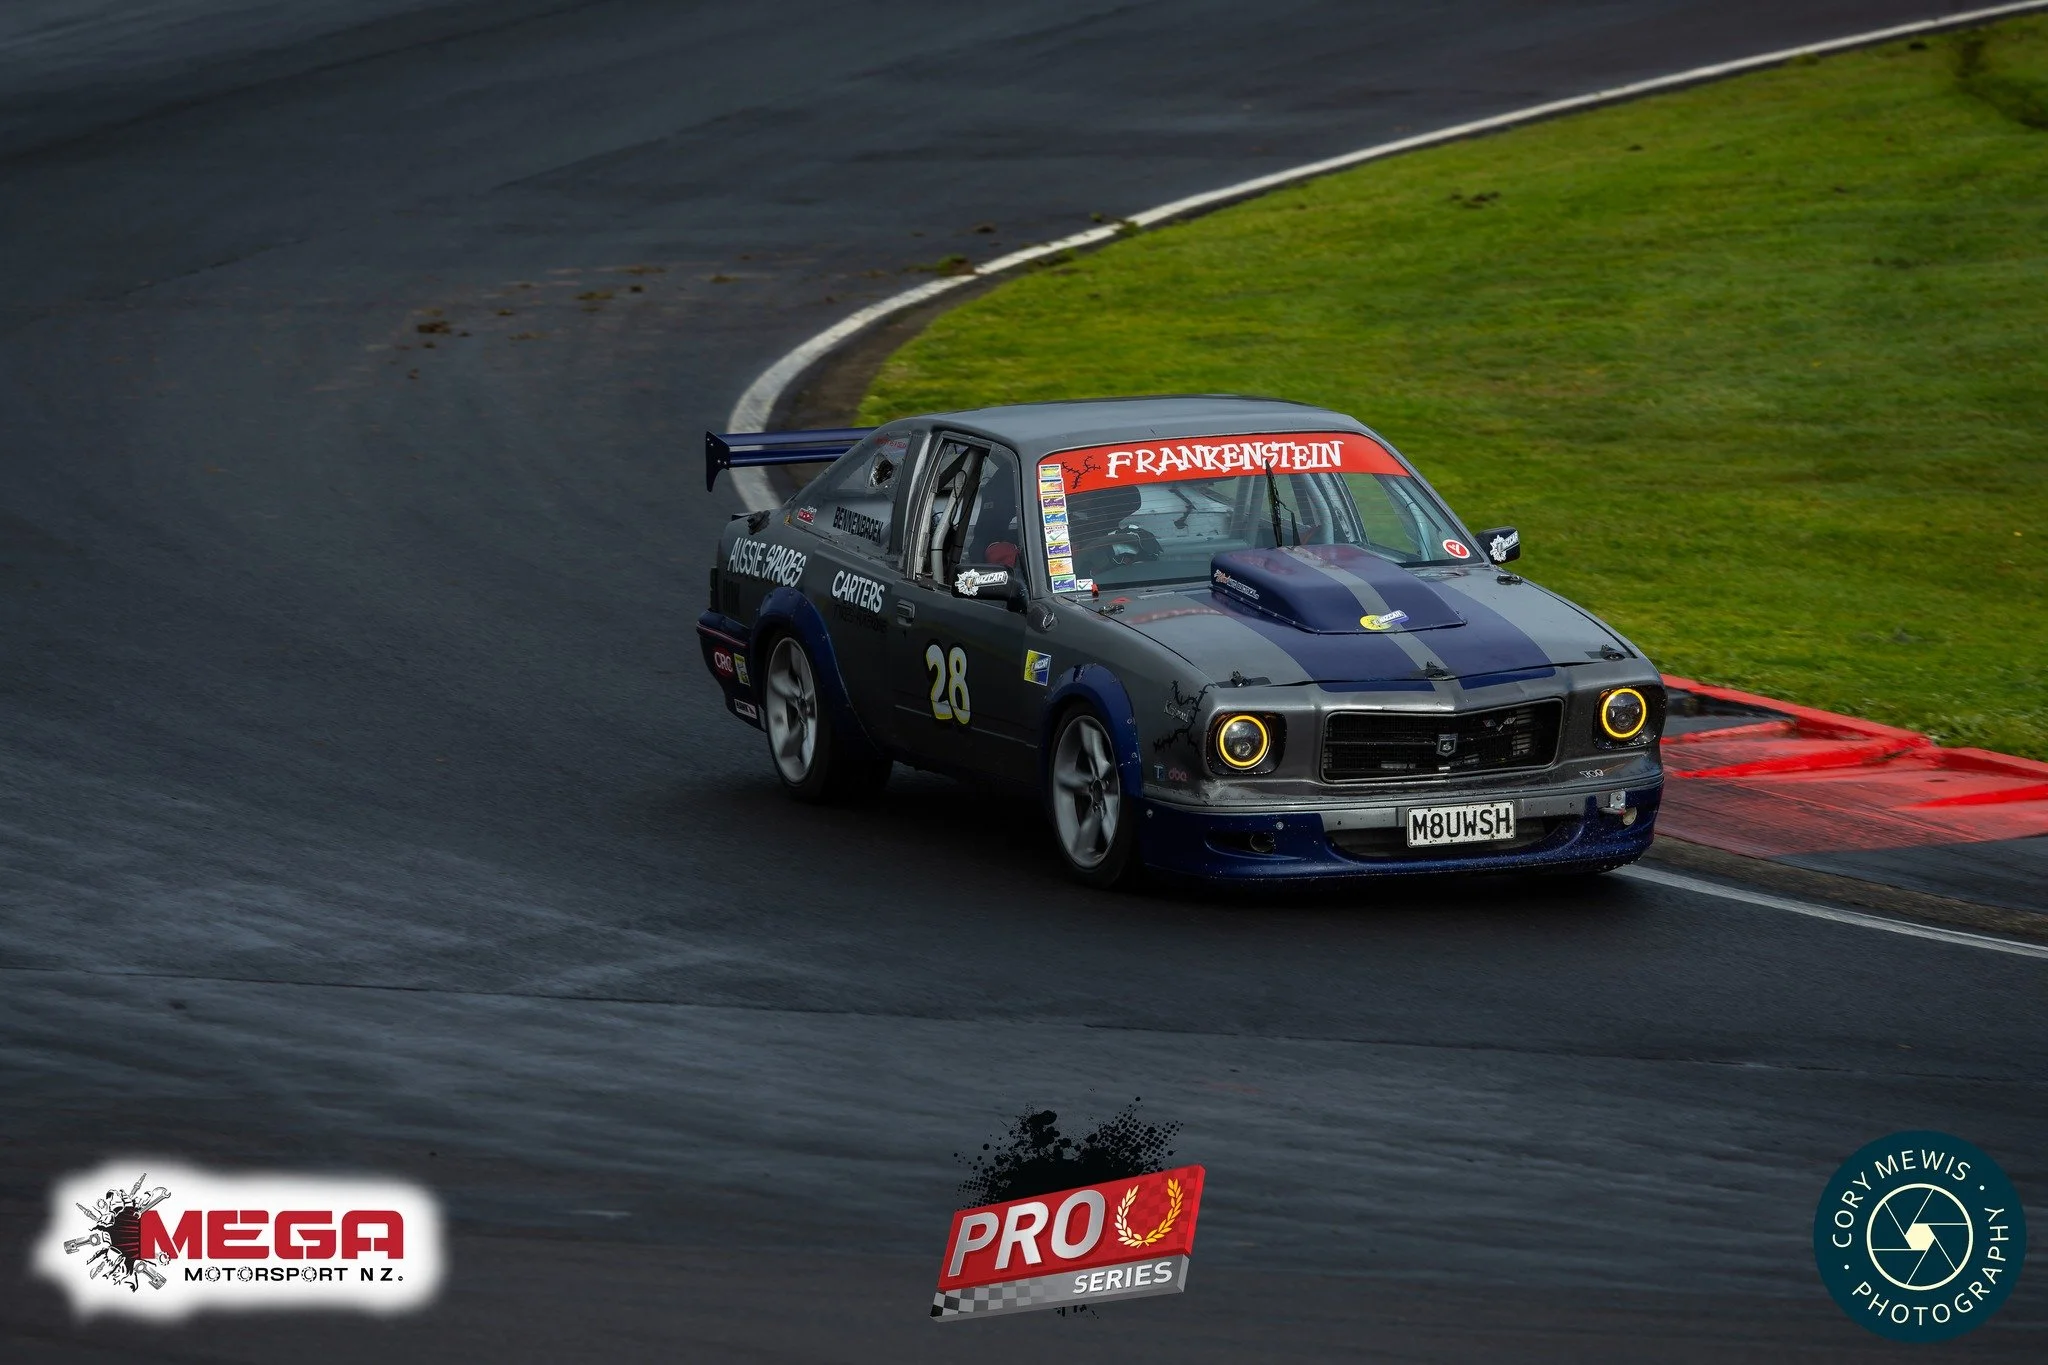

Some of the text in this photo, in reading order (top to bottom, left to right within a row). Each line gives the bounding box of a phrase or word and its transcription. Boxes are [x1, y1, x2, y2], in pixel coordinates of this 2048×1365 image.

[1105, 440, 1345, 479] FRANKENSTEIN
[727, 536, 808, 589] AUSSIE SPARES
[831, 569, 886, 614] CARTERS
[925, 644, 970, 725] 28
[1412, 807, 1511, 841] M8UWSH
